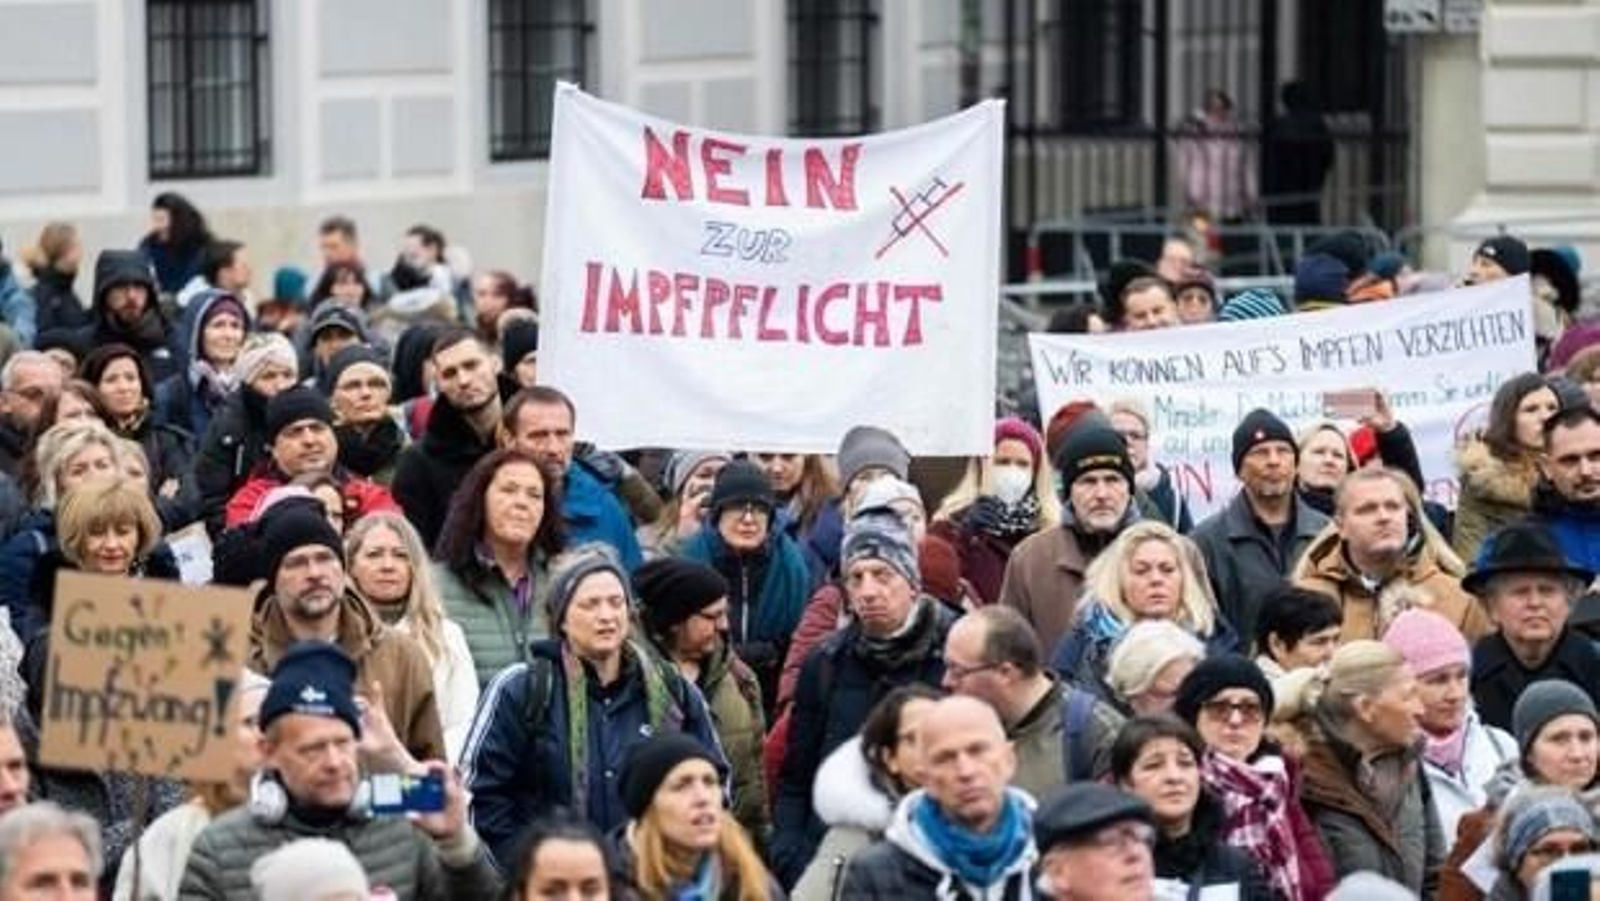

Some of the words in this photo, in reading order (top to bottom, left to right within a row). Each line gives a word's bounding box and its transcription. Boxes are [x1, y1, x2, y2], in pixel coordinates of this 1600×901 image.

[641, 125, 862, 211] NEIN
[702, 221, 793, 264] ZUR
[580, 261, 943, 347] IMPFPFLICHT
[1041, 349, 1093, 385] WIR
[1109, 353, 1205, 384] KÖNNEN
[1299, 331, 1384, 372] IMPFEN
[1397, 308, 1527, 359] VERZICHTEN
